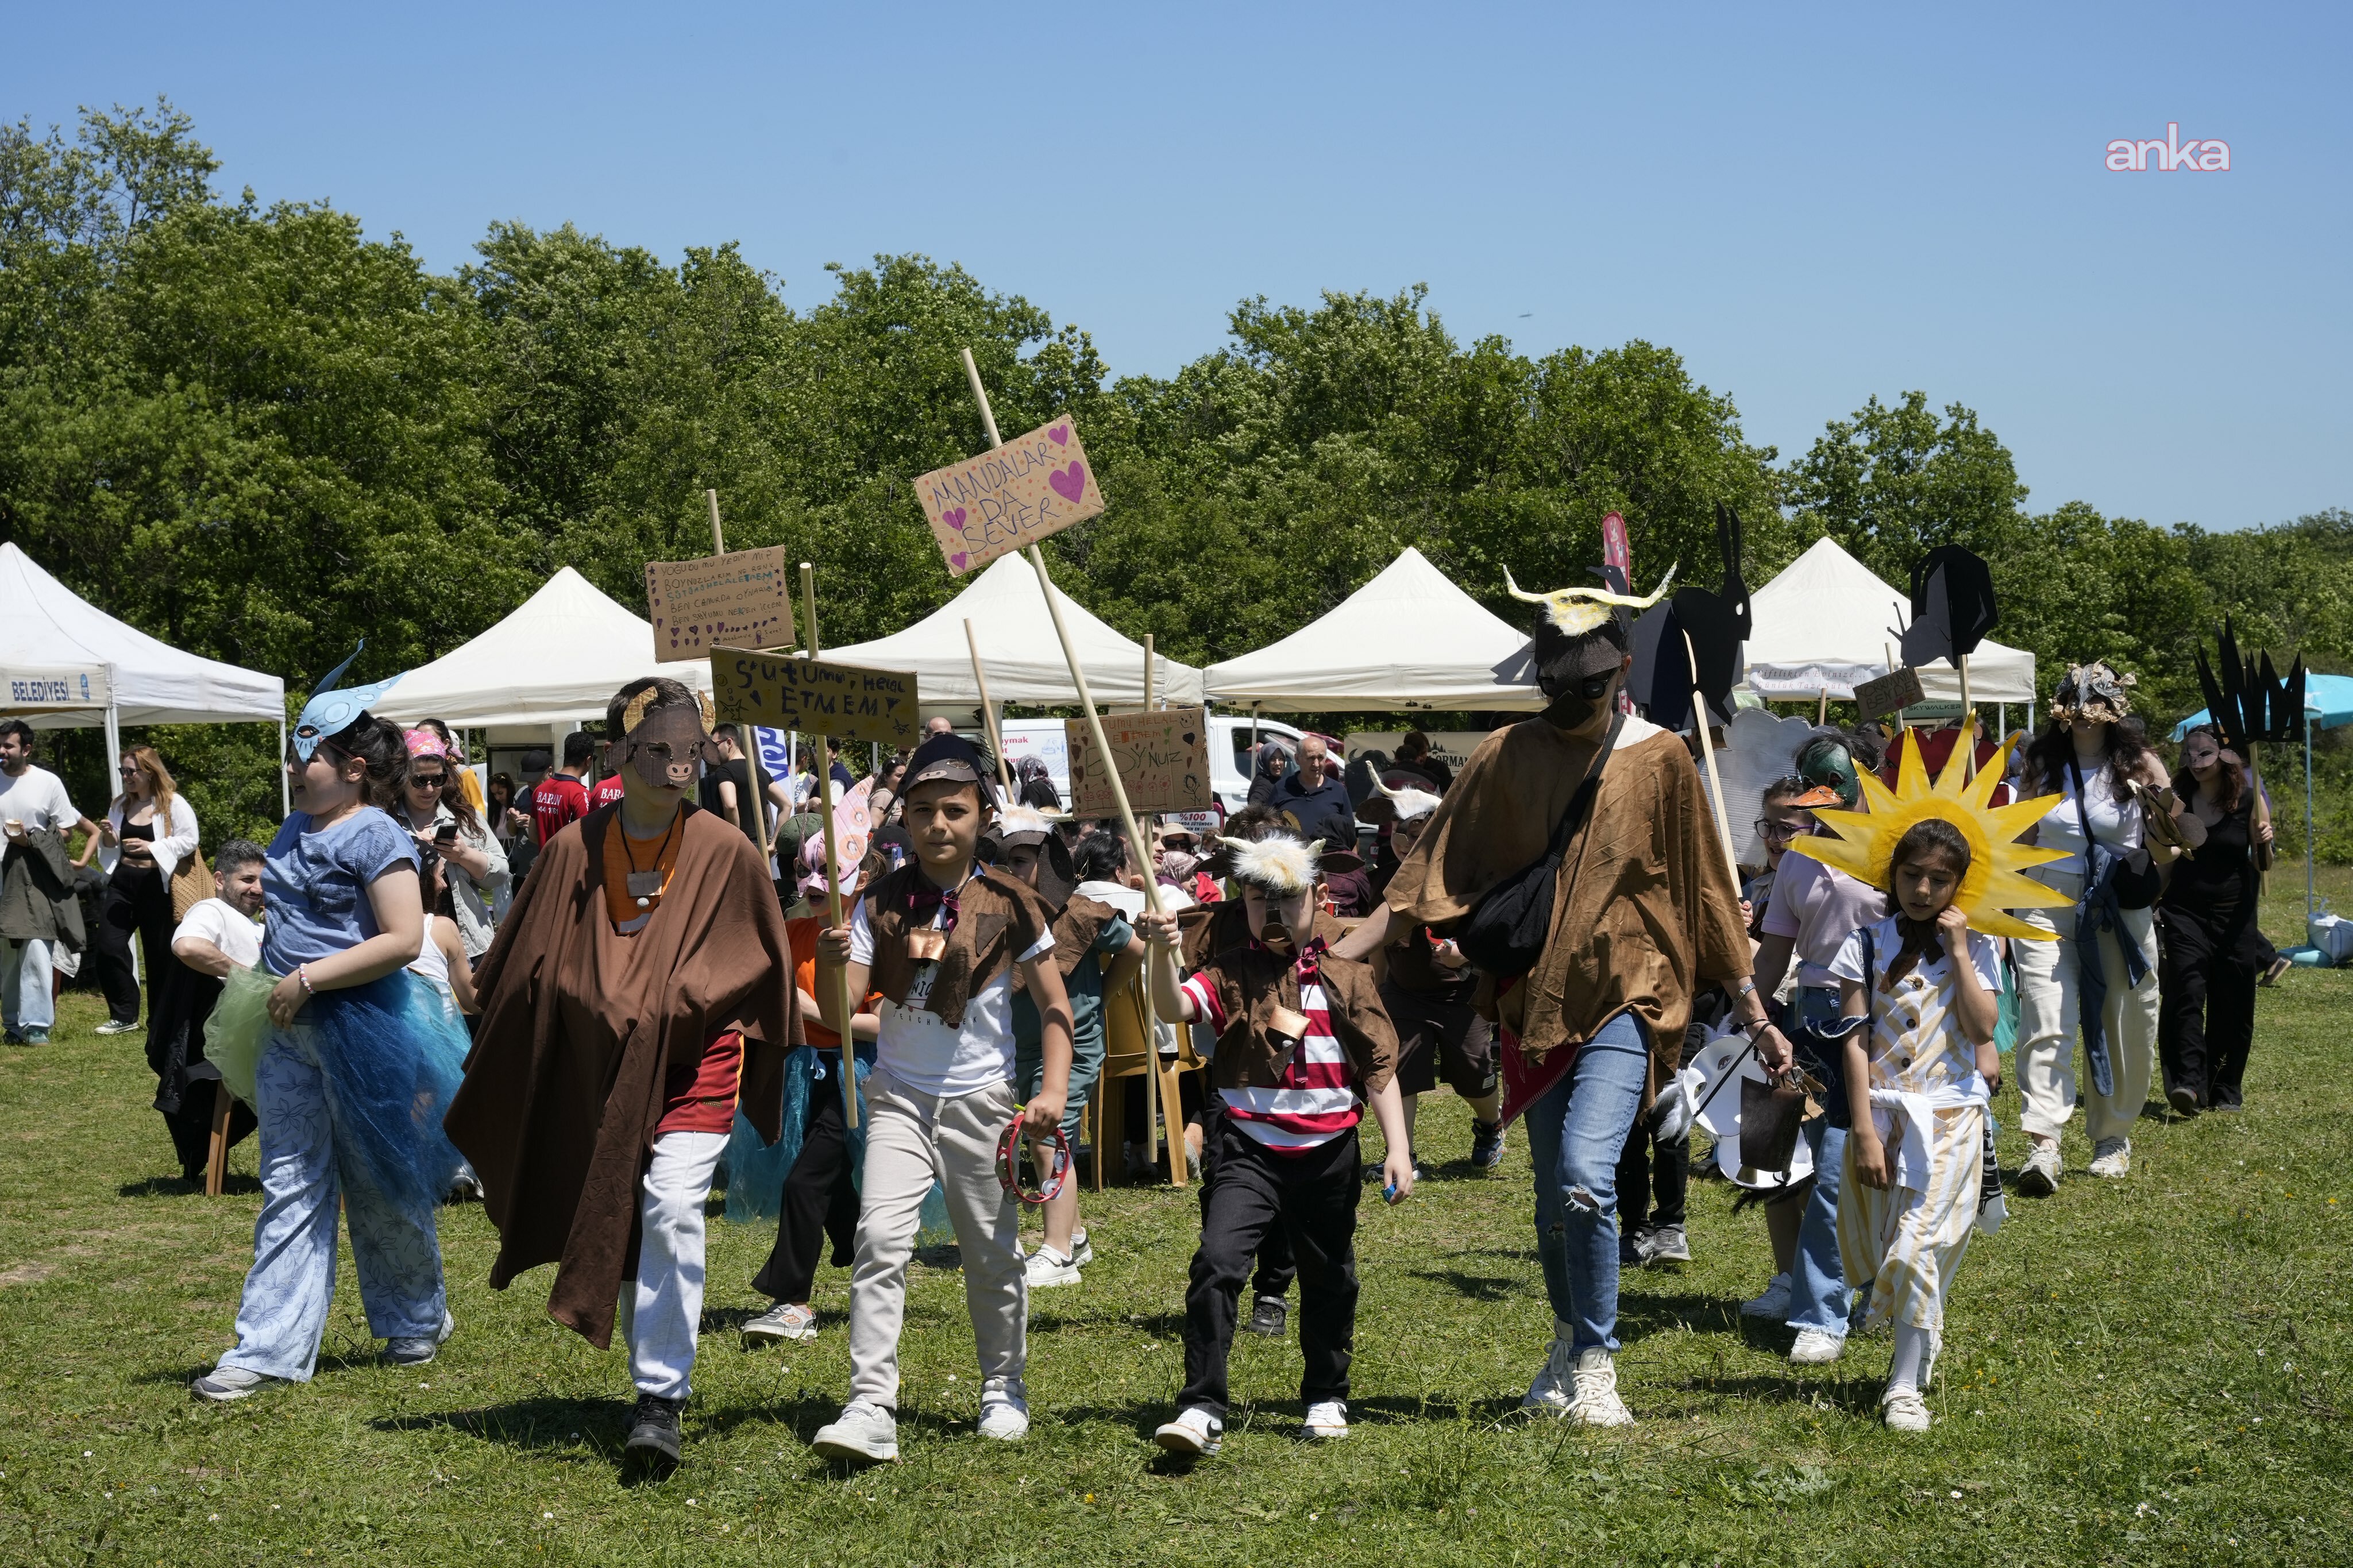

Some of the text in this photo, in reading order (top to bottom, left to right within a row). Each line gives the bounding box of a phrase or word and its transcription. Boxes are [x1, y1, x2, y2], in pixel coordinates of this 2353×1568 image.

[932, 442, 1057, 512] MANDALAR
[979, 489, 1032, 522] DA
[962, 497, 1062, 554] SEVER
[751, 563, 774, 571] RENK
[670, 601, 690, 613] BEN
[673, 615, 690, 626] BEN
[11, 676, 70, 701] BELEDİYESİ
[1757, 681, 1796, 690] Günlük
[1797, 681, 1821, 689] Taze
[1825, 681, 1841, 689] Süt
[781, 685, 901, 719] ETMEM!
[1138, 715, 1177, 727] HELAL
[1002, 736, 1028, 746] ymak
[940, 1016, 977, 1026] WEK
